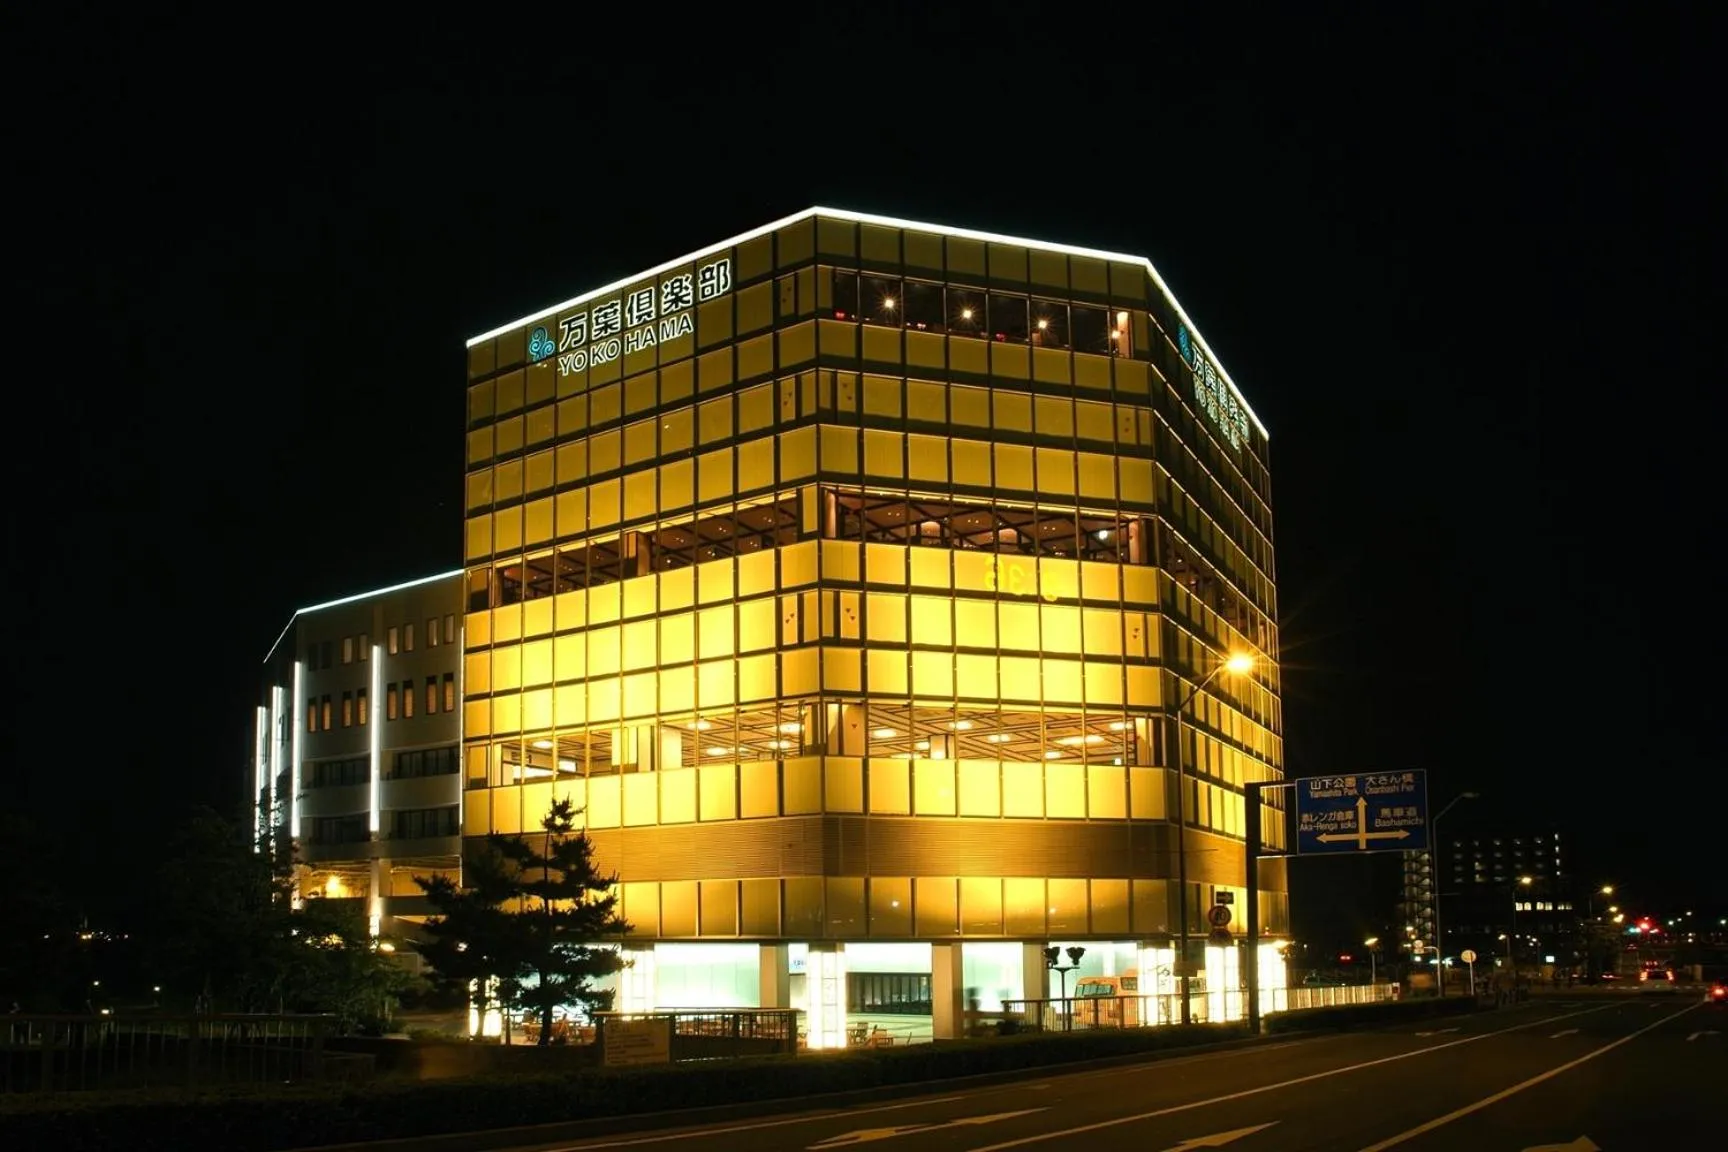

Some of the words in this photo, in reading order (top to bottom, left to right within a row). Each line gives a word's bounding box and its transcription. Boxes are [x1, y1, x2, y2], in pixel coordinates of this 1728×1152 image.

[558, 313, 694, 376] YOKOHAMA
[559, 259, 731, 352] 万葉倶楽部
